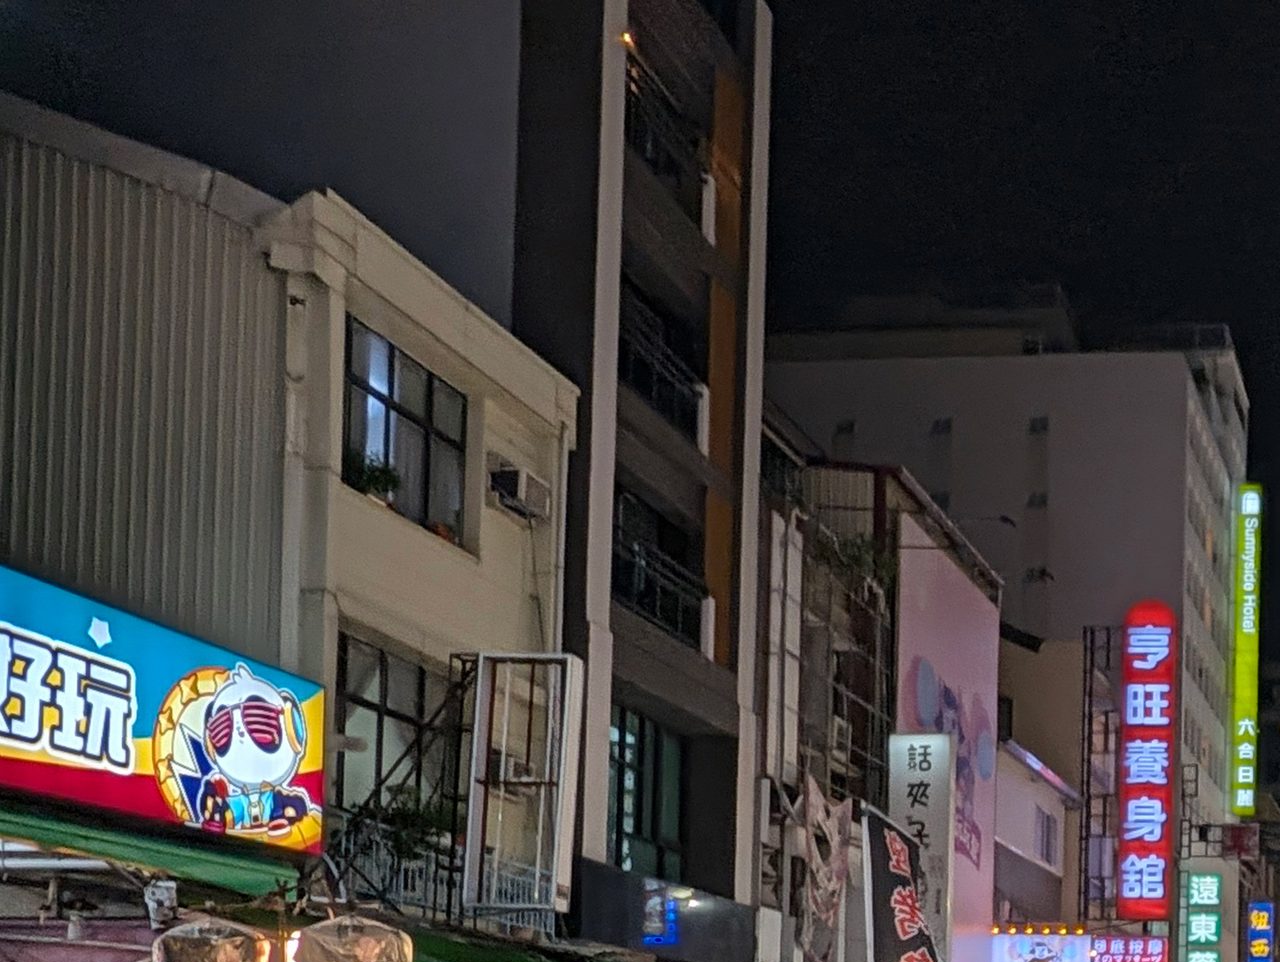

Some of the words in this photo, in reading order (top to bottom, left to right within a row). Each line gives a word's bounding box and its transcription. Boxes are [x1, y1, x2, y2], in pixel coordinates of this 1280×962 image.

[1242, 517, 1259, 591] Sunnyside
[1242, 595, 1257, 633] Hotel
[0, 628, 132, 768] 好玩
